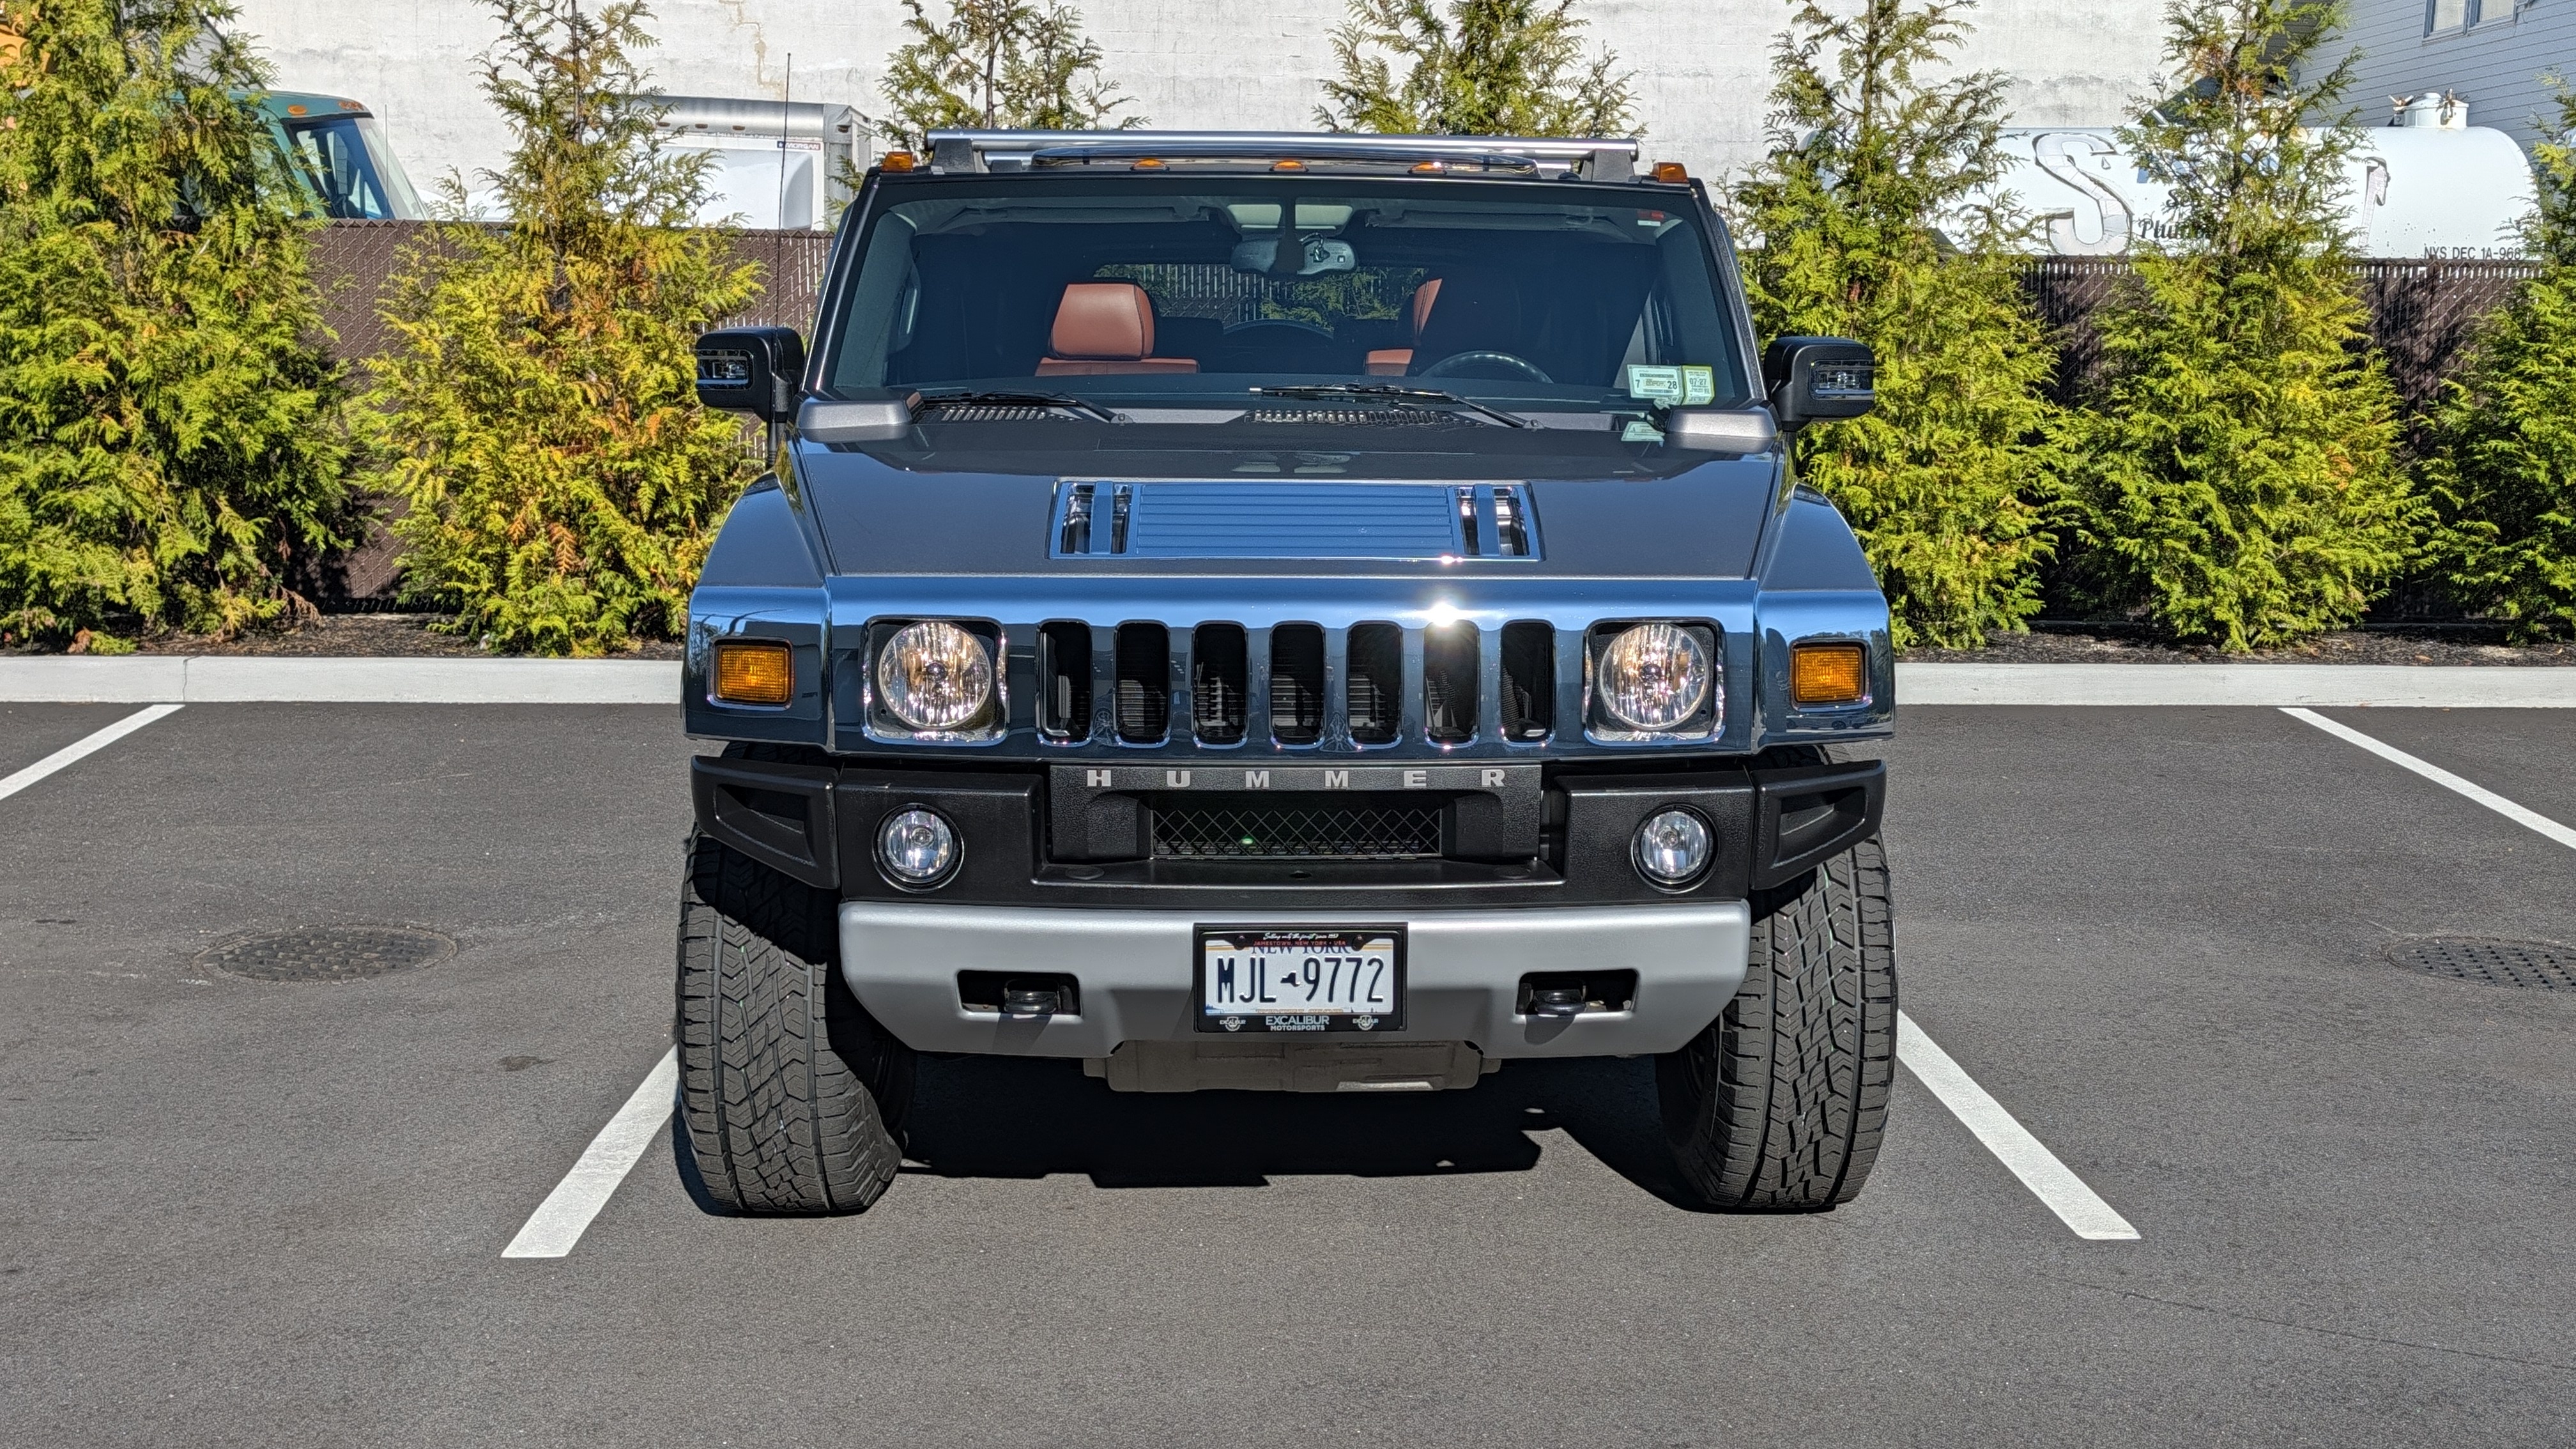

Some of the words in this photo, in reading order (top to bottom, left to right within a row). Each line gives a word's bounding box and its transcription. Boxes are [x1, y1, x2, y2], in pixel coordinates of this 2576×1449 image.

[2425, 246, 2447, 259] NYS
[2452, 247, 2476, 260] DEC
[1635, 379, 1641, 388] 7
[1667, 380, 1678, 390] 28
[1086, 769, 1505, 788] HUMMER
[1218, 956, 1276, 1003] MJL
[1303, 956, 1384, 1003] 9772
[1266, 1015, 1330, 1025] EXCALIBUR
